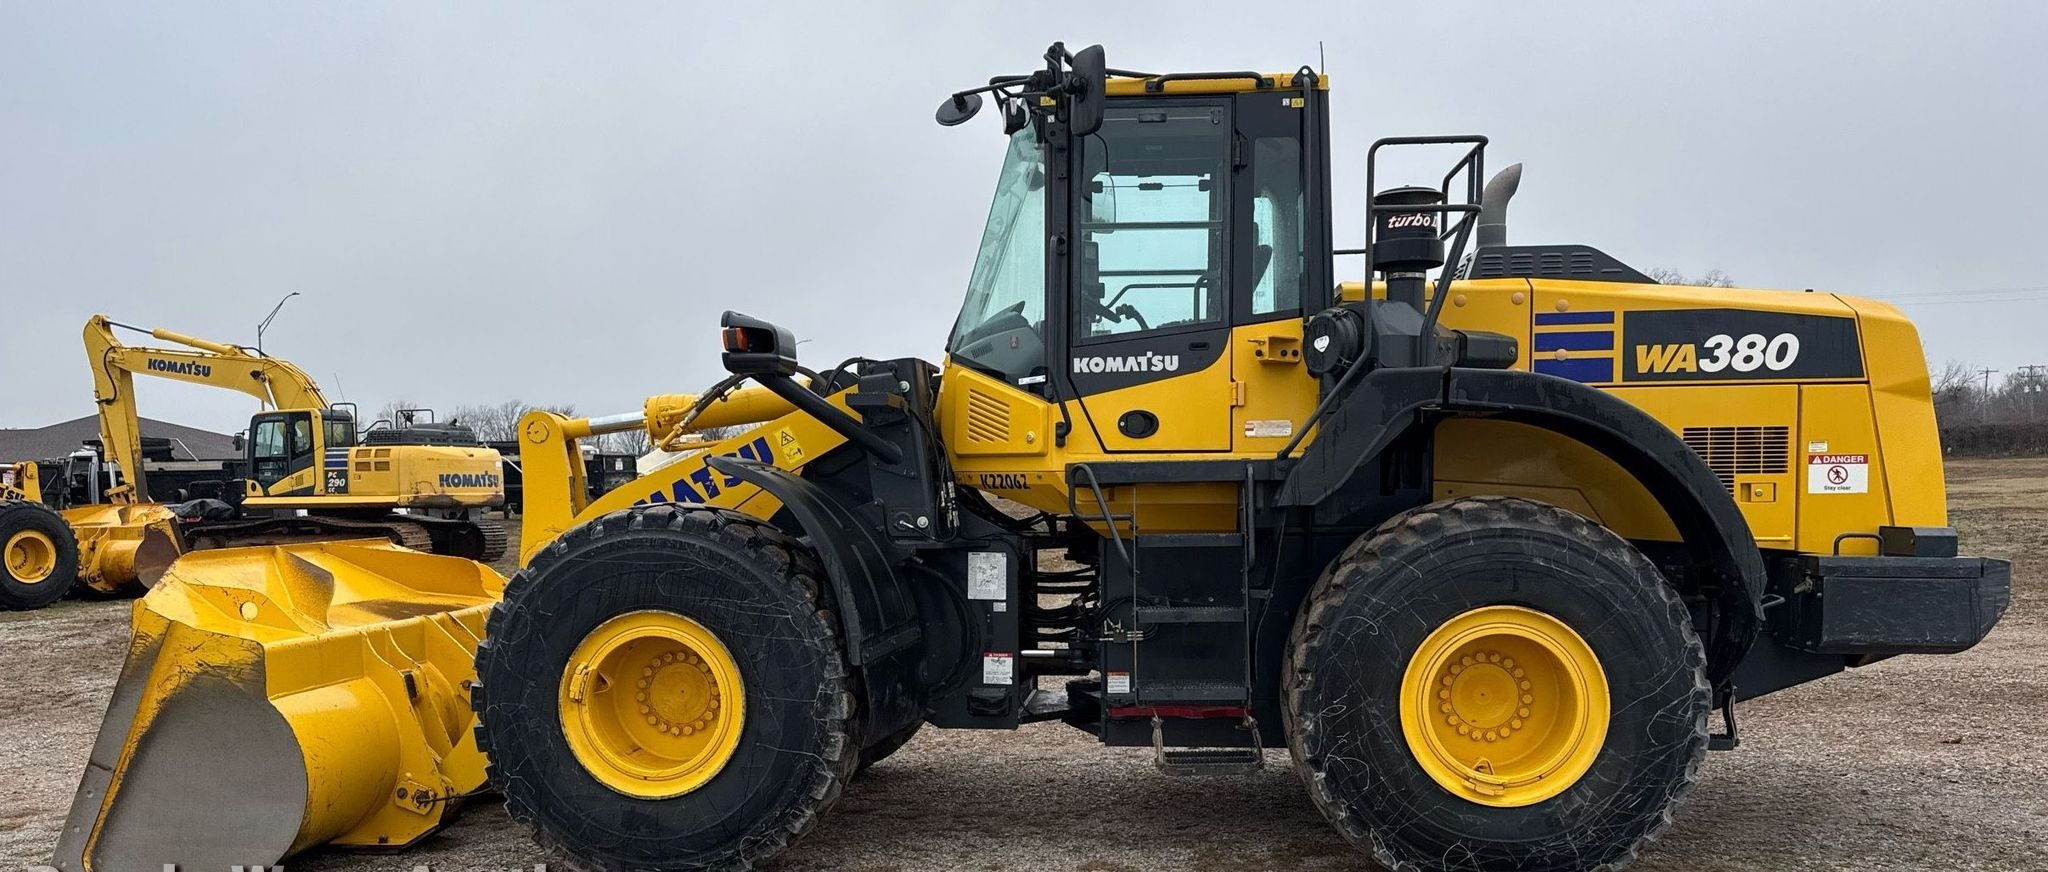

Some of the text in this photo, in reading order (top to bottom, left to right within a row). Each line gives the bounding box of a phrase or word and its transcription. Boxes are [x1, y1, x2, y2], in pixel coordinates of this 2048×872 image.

[1387, 213, 1431, 229] turbo
[1073, 350, 1180, 374] KOMATSU
[1635, 332, 1801, 375] WA380
[147, 358, 212, 378] KOMATSU
[328, 478, 345, 487] 290
[438, 470, 499, 488] KOMATSU
[980, 473, 1031, 490] K22062
